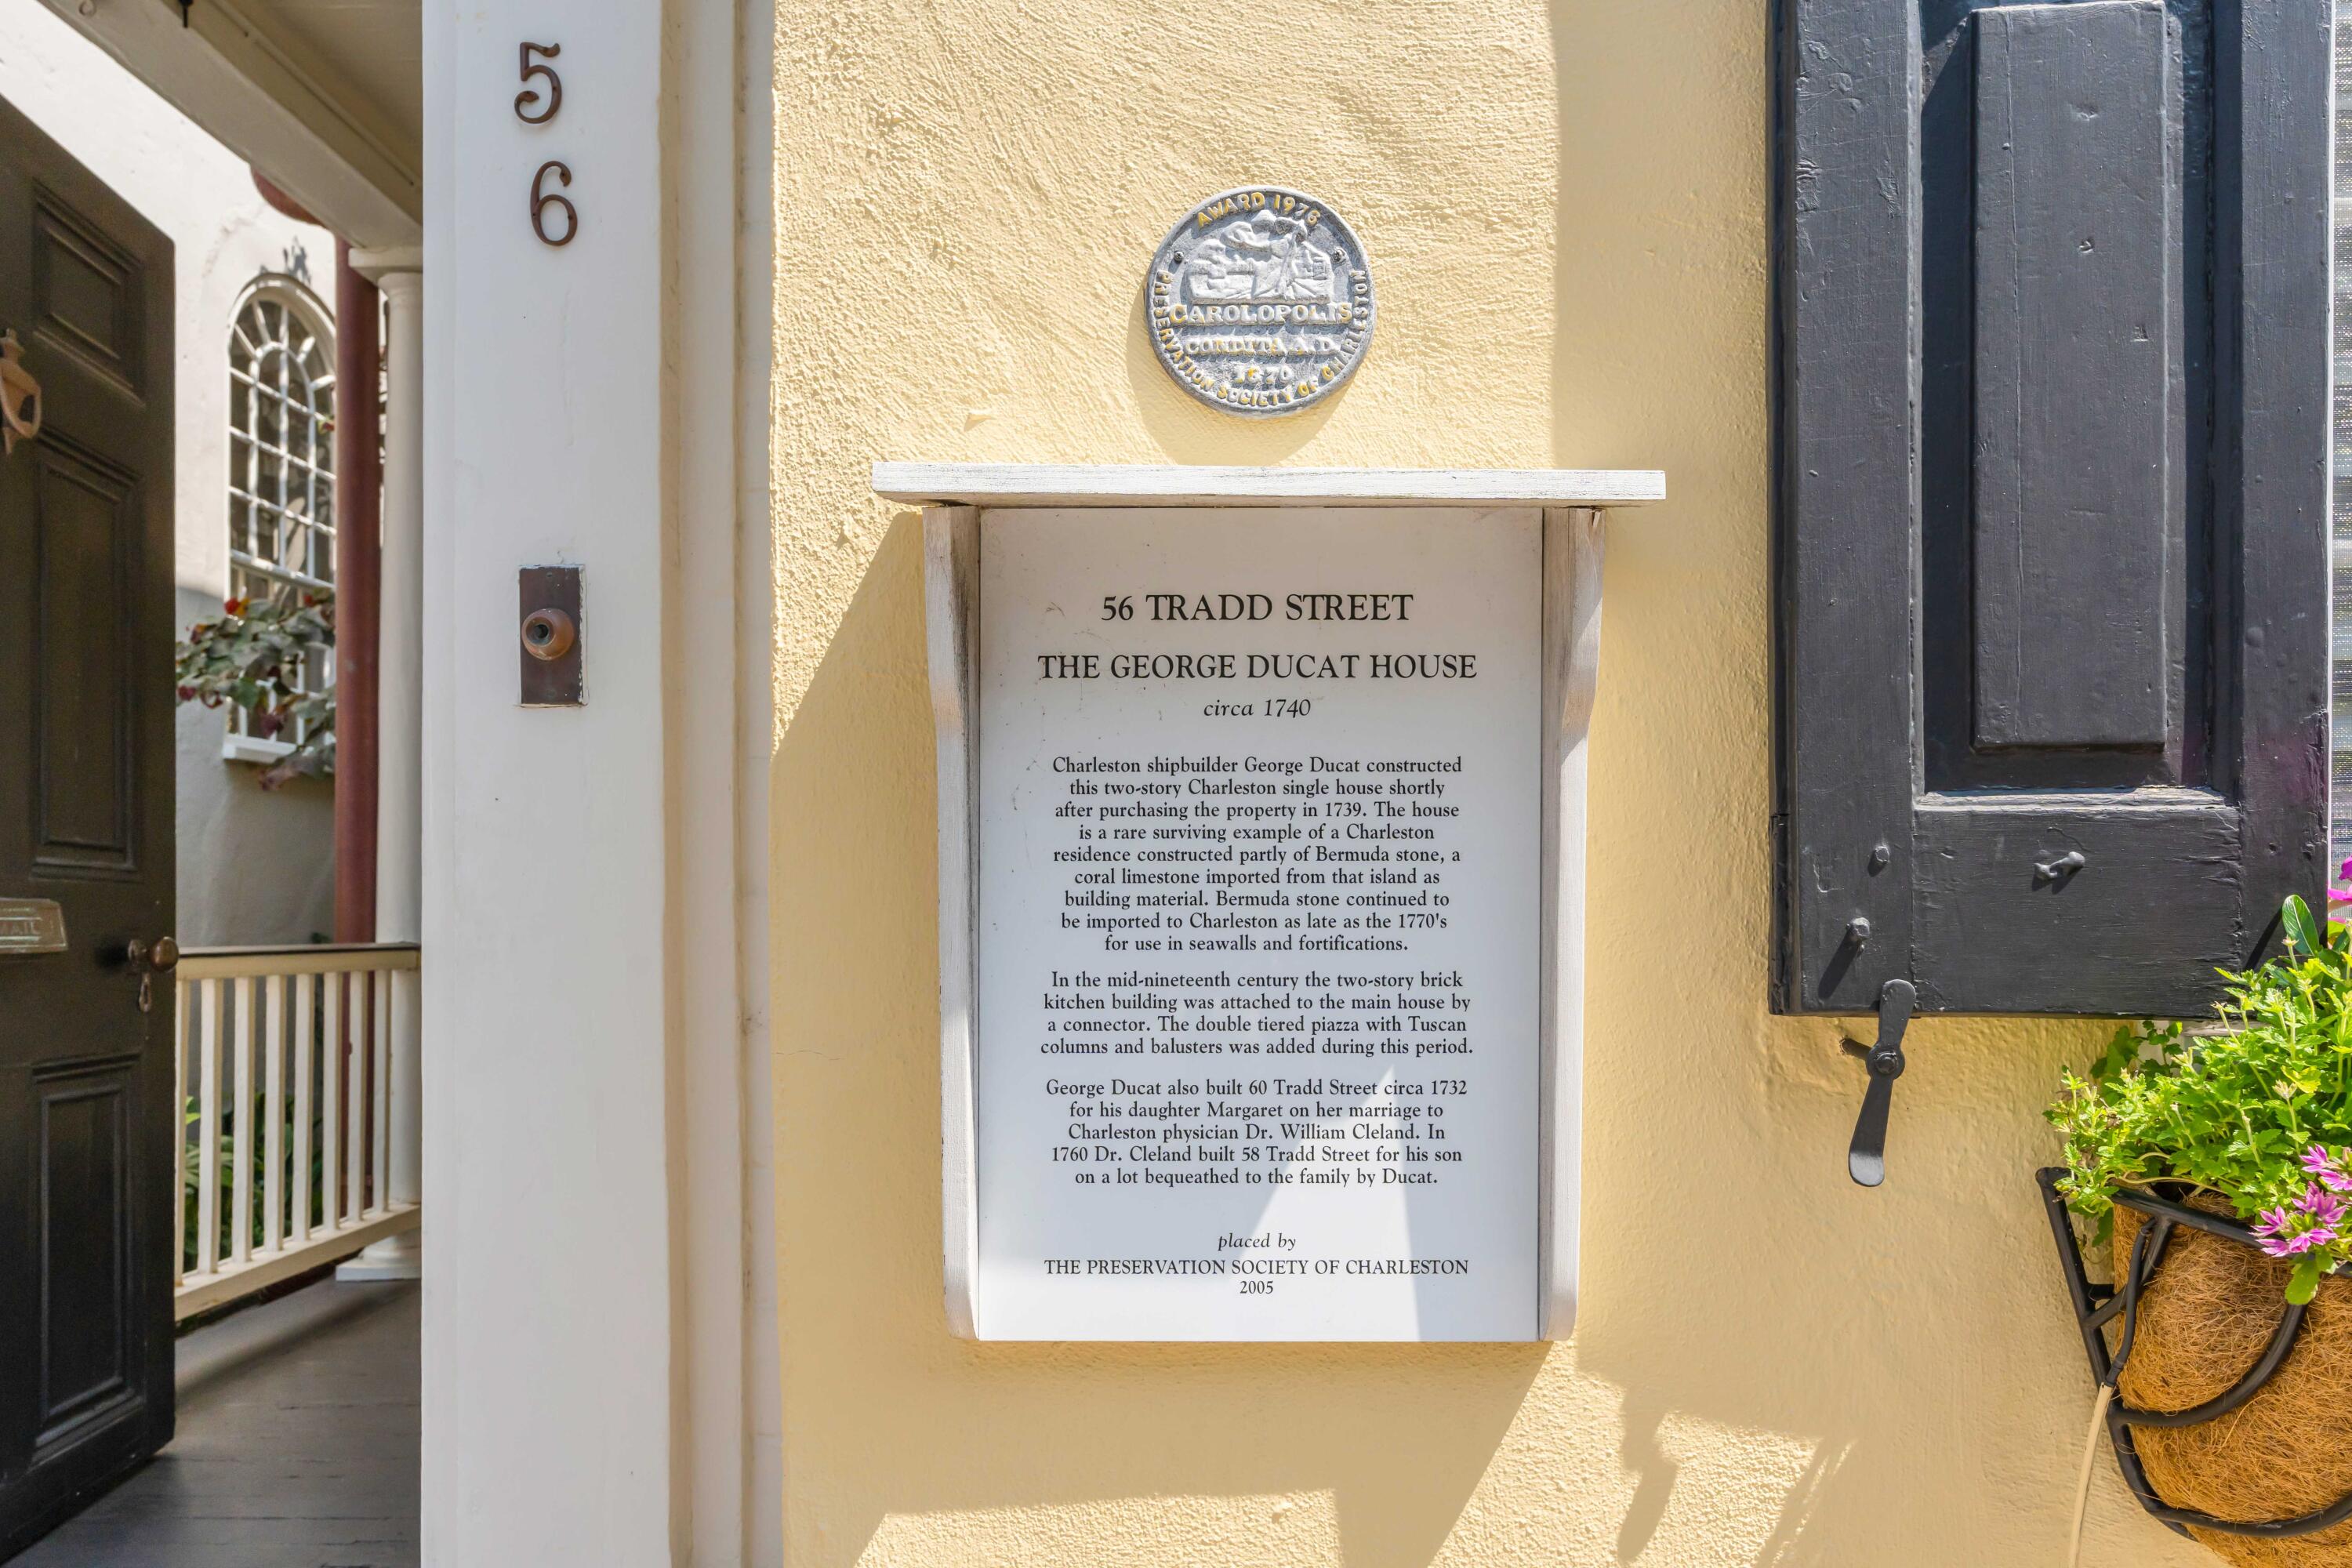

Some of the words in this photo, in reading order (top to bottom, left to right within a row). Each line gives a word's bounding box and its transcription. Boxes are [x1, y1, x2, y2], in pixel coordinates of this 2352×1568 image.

[1196, 192, 1265, 228] AWARD
[1169, 303, 1352, 325] CAROLOPOLIS
[1152, 269, 1215, 392] PRESERVATION
[1217, 383, 1294, 407] SOCIETY
[1296, 376, 1319, 397] OF
[1321, 269, 1369, 382] CHARLESTON
[1101, 595, 1134, 621] 56
[1145, 593, 1273, 621] TRADD
[1285, 593, 1414, 621] STREET
[1037, 655, 1101, 679] THE
[1110, 654, 1236, 679] GEORGE
[1246, 654, 1360, 679] DUCAT
[1369, 654, 1478, 679] HOUSE
[1203, 699, 1254, 717] circa
[1264, 699, 1312, 719] 1740
[1052, 756, 1142, 773] Charleston
[1147, 755, 1239, 777] shipbuilder
[1244, 756, 1304, 776] George
[1309, 756, 1360, 772] Ducat
[1367, 755, 1462, 773] constructed
[1069, 778, 1098, 795] this
[1104, 782, 1181, 799] two-story
[1188, 778, 1277, 795] Charleston
[1283, 778, 1330, 799] single
[1335, 778, 1383, 795] house
[1389, 778, 1445, 799] shortly
[1055, 800, 1094, 818] after
[1099, 800, 1189, 822] purchasing
[1194, 800, 1220, 818] the
[1226, 804, 1297, 821] property
[1302, 801, 1319, 817] in
[1325, 801, 1367, 818] 1739.
[1374, 800, 1406, 817] The
[1411, 800, 1460, 818] house
[1053, 844, 1131, 862] residence
[1137, 844, 1233, 862] constructed
[1239, 844, 1287, 866] partly
[1293, 844, 1312, 862] of
[1315, 844, 1390, 862] Bermuda
[1396, 849, 1445, 865] stone,
[1451, 851, 1461, 862] a
[1065, 889, 1131, 910] building
[1136, 889, 1209, 906] material.
[1215, 889, 1290, 906] Bermuda
[1296, 893, 1340, 906] stone
[1346, 889, 1428, 906] continued
[1432, 893, 1450, 906] to
[1061, 912, 1080, 929] be
[1086, 911, 1161, 933] imported
[1166, 916, 1183, 928] to
[1189, 911, 1279, 928] Charleston
[1284, 917, 1301, 929] as
[1307, 912, 1337, 929] late
[1343, 917, 1360, 929] as
[1365, 911, 1392, 929] the
[1398, 912, 1447, 929] 1770's
[1104, 934, 1129, 951] for
[1134, 940, 1162, 951] use
[1167, 935, 1184, 951] in
[1189, 934, 1257, 951] seawalls
[1263, 934, 1293, 951] and
[1298, 934, 1408, 951] fortifications.
[1051, 971, 1070, 987] In
[1075, 970, 1102, 987] the
[1107, 970, 1231, 987] mid-nineteenth
[1236, 974, 1299, 991] century
[1305, 970, 1331, 987] the
[1337, 974, 1414, 991] two-story
[1420, 970, 1464, 987] brick
[1044, 993, 1105, 1010] kitchen
[1111, 992, 1178, 1014] building
[1183, 998, 1214, 1010] was
[1221, 992, 1291, 1010] attached
[1296, 996, 1313, 1010] to
[1319, 993, 1345, 1010] the
[1351, 993, 1392, 1010] main
[1397, 993, 1445, 1010] house
[1451, 993, 1471, 1012] by
[1047, 1021, 1057, 1032] a
[1063, 1018, 1151, 1032] connector.
[1157, 1014, 1189, 1032] The
[1195, 1014, 1251, 1032] double
[1257, 1014, 1305, 1032] tiered
[1311, 1015, 1359, 1036] piazza
[1366, 1014, 1403, 1032] with
[1407, 1015, 1467, 1033] Tuscan
[1040, 1037, 1109, 1054] columns
[1114, 1036, 1145, 1054] and
[1150, 1036, 1223, 1054] balusters
[1229, 1043, 1260, 1054] was
[1266, 1036, 1316, 1054] added
[1322, 1036, 1375, 1058] during
[1380, 1037, 1409, 1054] this
[1415, 1036, 1473, 1058] period.
[1046, 1079, 1105, 1099] George
[1110, 1079, 1162, 1095] Ducat
[1167, 1078, 1200, 1095] also
[1206, 1078, 1243, 1095] built
[1248, 1080, 1268, 1095] 60
[1272, 1078, 1323, 1095] Tradd
[1329, 1079, 1378, 1095] Street
[1384, 1079, 1425, 1095] circa
[1431, 1080, 1468, 1095] 1732
[1069, 1100, 1094, 1117] for
[1099, 1100, 1122, 1117] his
[1128, 1100, 1201, 1121] daughter
[1207, 1101, 1283, 1121] Margaret
[1289, 1106, 1310, 1117] on
[1316, 1100, 1343, 1117] her
[1348, 1102, 1421, 1121] marriage
[1427, 1104, 1443, 1117] to
[1068, 1123, 1157, 1140] Charleston
[1163, 1123, 1240, 1144] physician
[1245, 1123, 1273, 1140] Dr.
[1279, 1123, 1346, 1140] William
[1352, 1122, 1421, 1140] Cleland.
[1427, 1123, 1446, 1140] In
[1051, 1146, 1088, 1162] 1760
[1094, 1145, 1123, 1162] Dr.
[1129, 1145, 1192, 1162] Cleland
[1198, 1145, 1236, 1162] built
[1241, 1146, 1260, 1162] 58
[1265, 1145, 1316, 1162] Tradd
[1321, 1145, 1370, 1162] Street
[1375, 1145, 1400, 1162] for
[1406, 1145, 1428, 1162] his
[1435, 1151, 1462, 1162] son
[1075, 1173, 1095, 1184] on
[1101, 1173, 1111, 1184] a
[1116, 1167, 1138, 1184] lot
[1145, 1167, 1240, 1188] bequeathed
[1245, 1171, 1261, 1184] to
[1267, 1167, 1294, 1184] the
[1299, 1167, 1351, 1189] family
[1356, 1167, 1376, 1189] by
[1381, 1167, 1438, 1184] Ducat.
[1218, 1232, 1271, 1252] placed
[1278, 1232, 1296, 1251] by
[1044, 1259, 1081, 1275] THE
[1087, 1259, 1226, 1275] PRESERVATION
[1231, 1259, 1309, 1275] SOCIETY
[1314, 1259, 1340, 1275] OF
[1345, 1259, 1468, 1275] CHARLESTON
[1240, 1280, 1274, 1294] 2005
